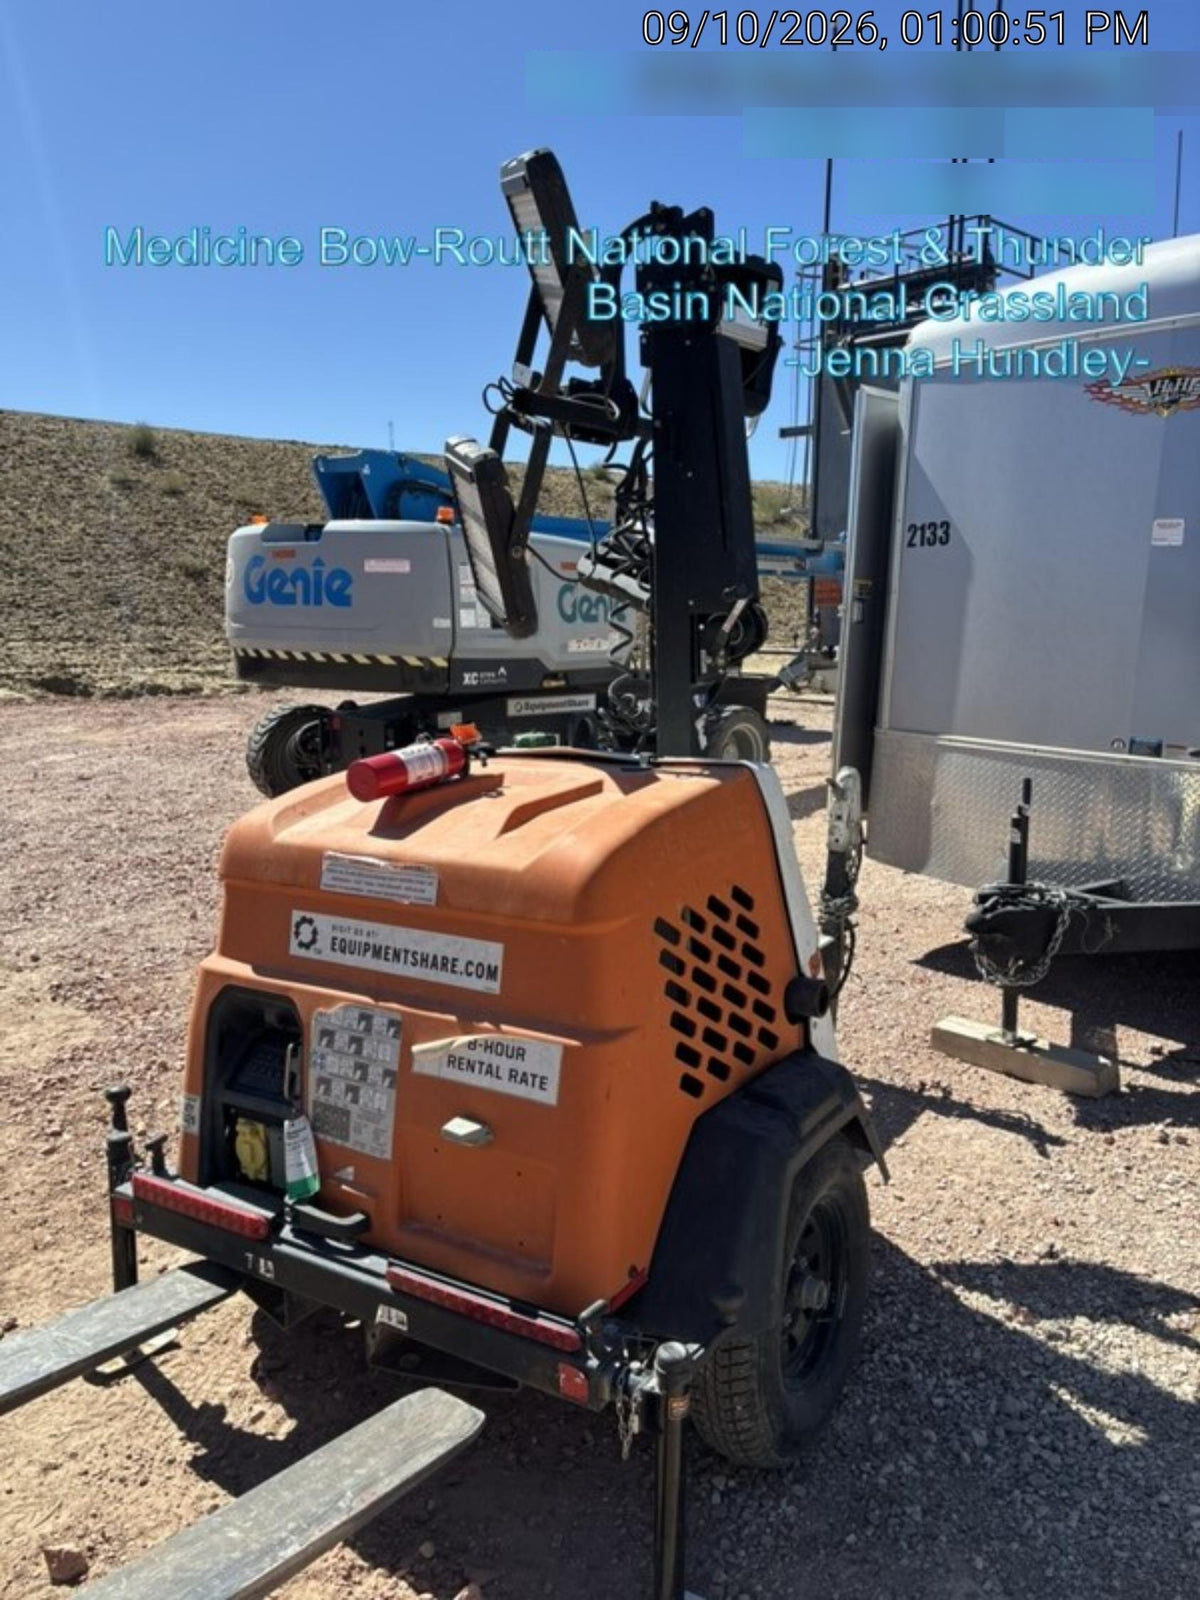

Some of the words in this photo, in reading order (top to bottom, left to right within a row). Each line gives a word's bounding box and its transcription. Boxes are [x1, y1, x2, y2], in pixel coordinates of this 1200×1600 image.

[906, 520, 951, 548] 2133
[243, 554, 353, 608] Genie
[558, 583, 627, 624] Gen
[330, 936, 499, 983] EQUIPMENTSHARE.COM
[447, 1054, 503, 1081] RENTAL
[508, 1067, 549, 1092] RATE
